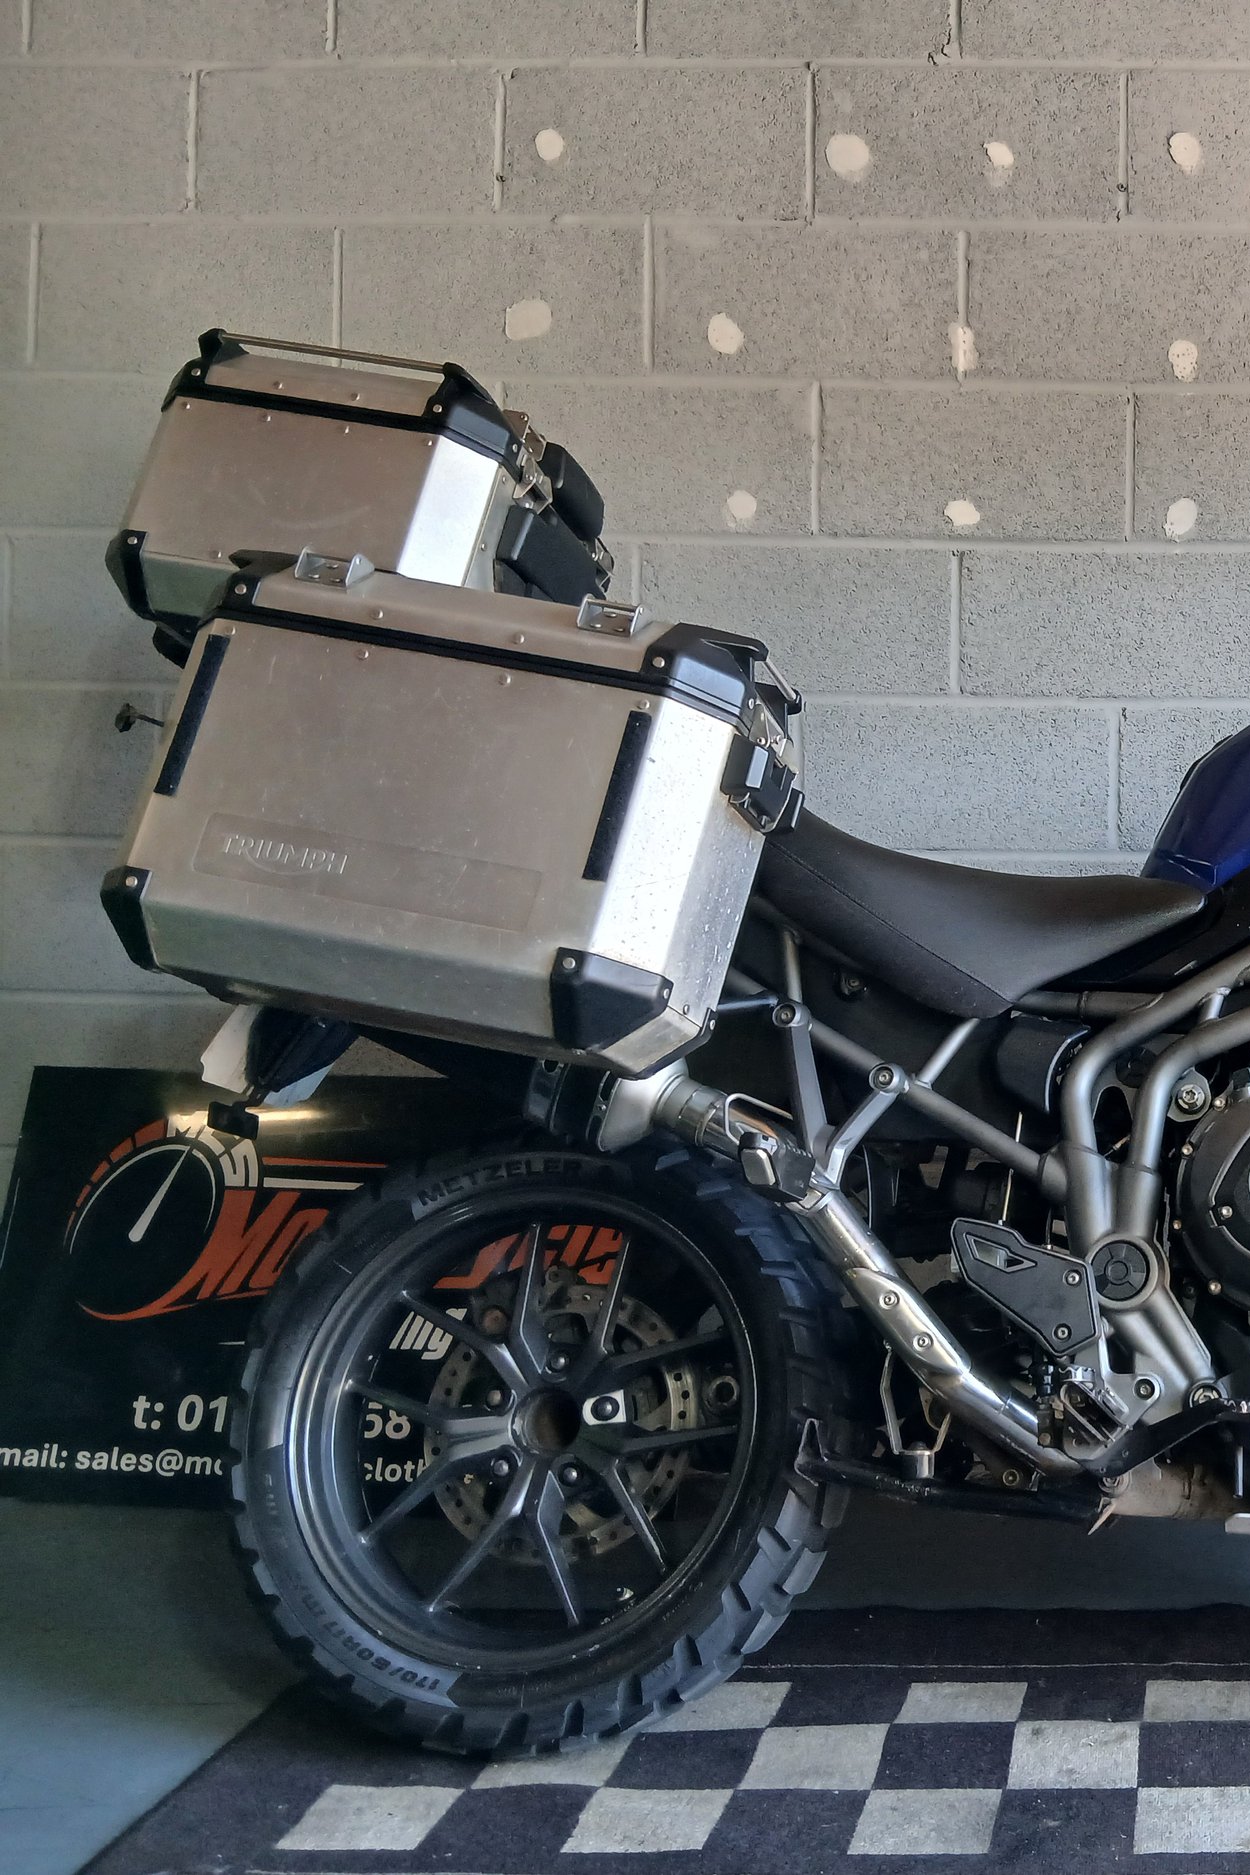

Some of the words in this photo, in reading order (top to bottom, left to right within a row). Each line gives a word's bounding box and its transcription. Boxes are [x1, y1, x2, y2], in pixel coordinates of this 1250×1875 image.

[223, 834, 348, 875] TRIUMPH
[416, 1157, 587, 1207] METZELER
[132, 1395, 164, 1430] t:
